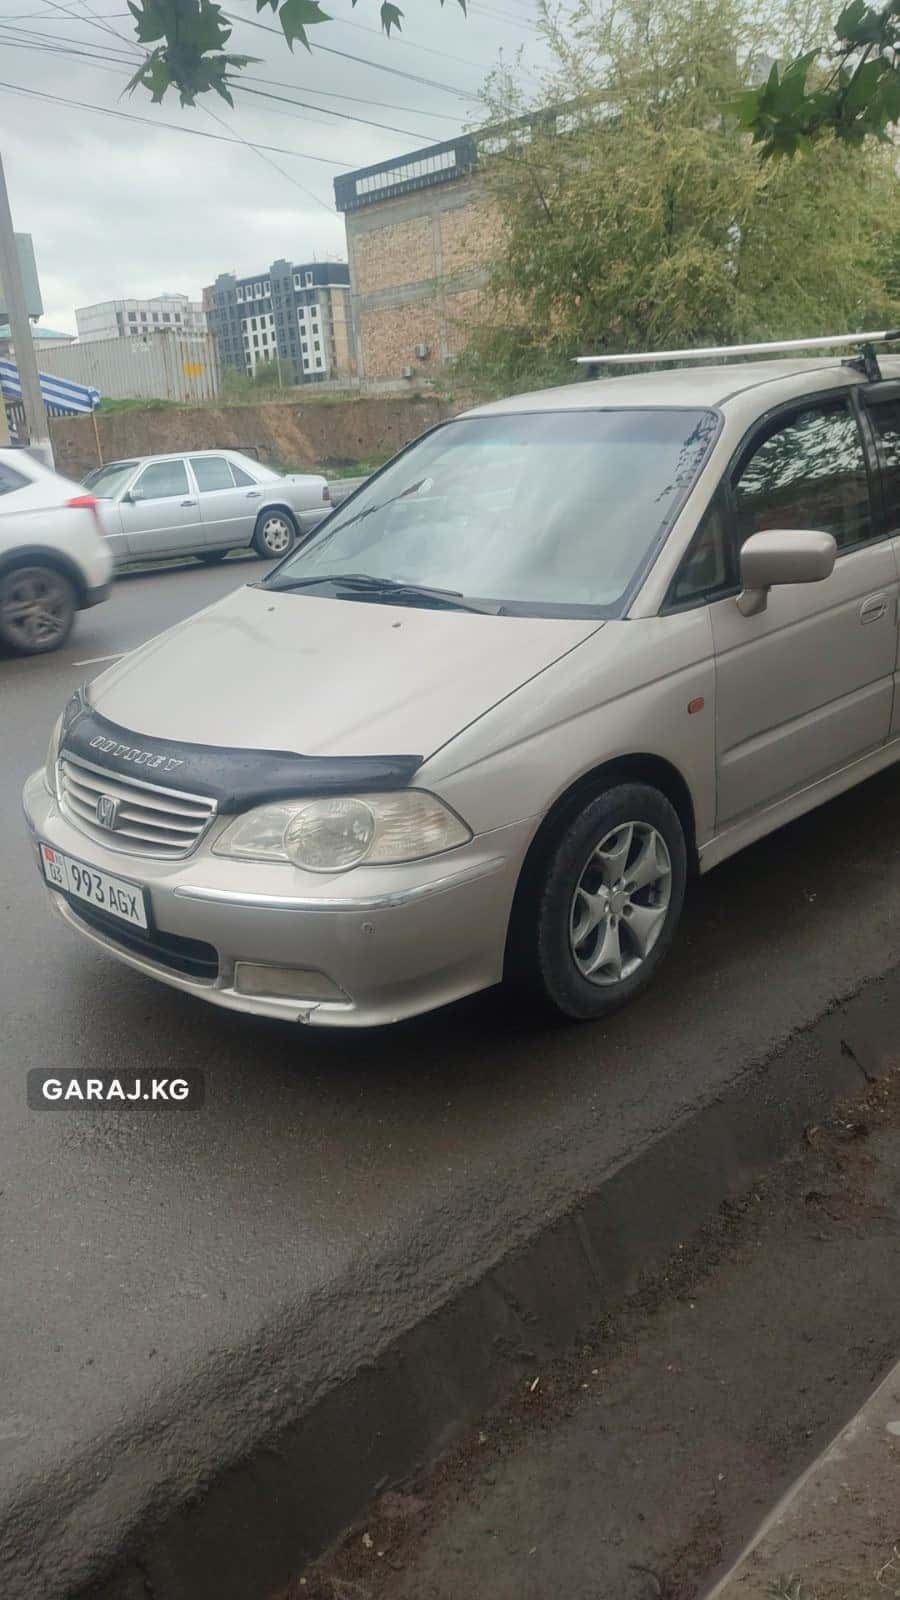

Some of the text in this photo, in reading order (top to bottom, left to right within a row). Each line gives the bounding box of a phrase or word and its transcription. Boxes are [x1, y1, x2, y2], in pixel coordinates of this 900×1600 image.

[89, 735, 184, 771] ODYSSEY
[71, 864, 140, 921] 993 AGX
